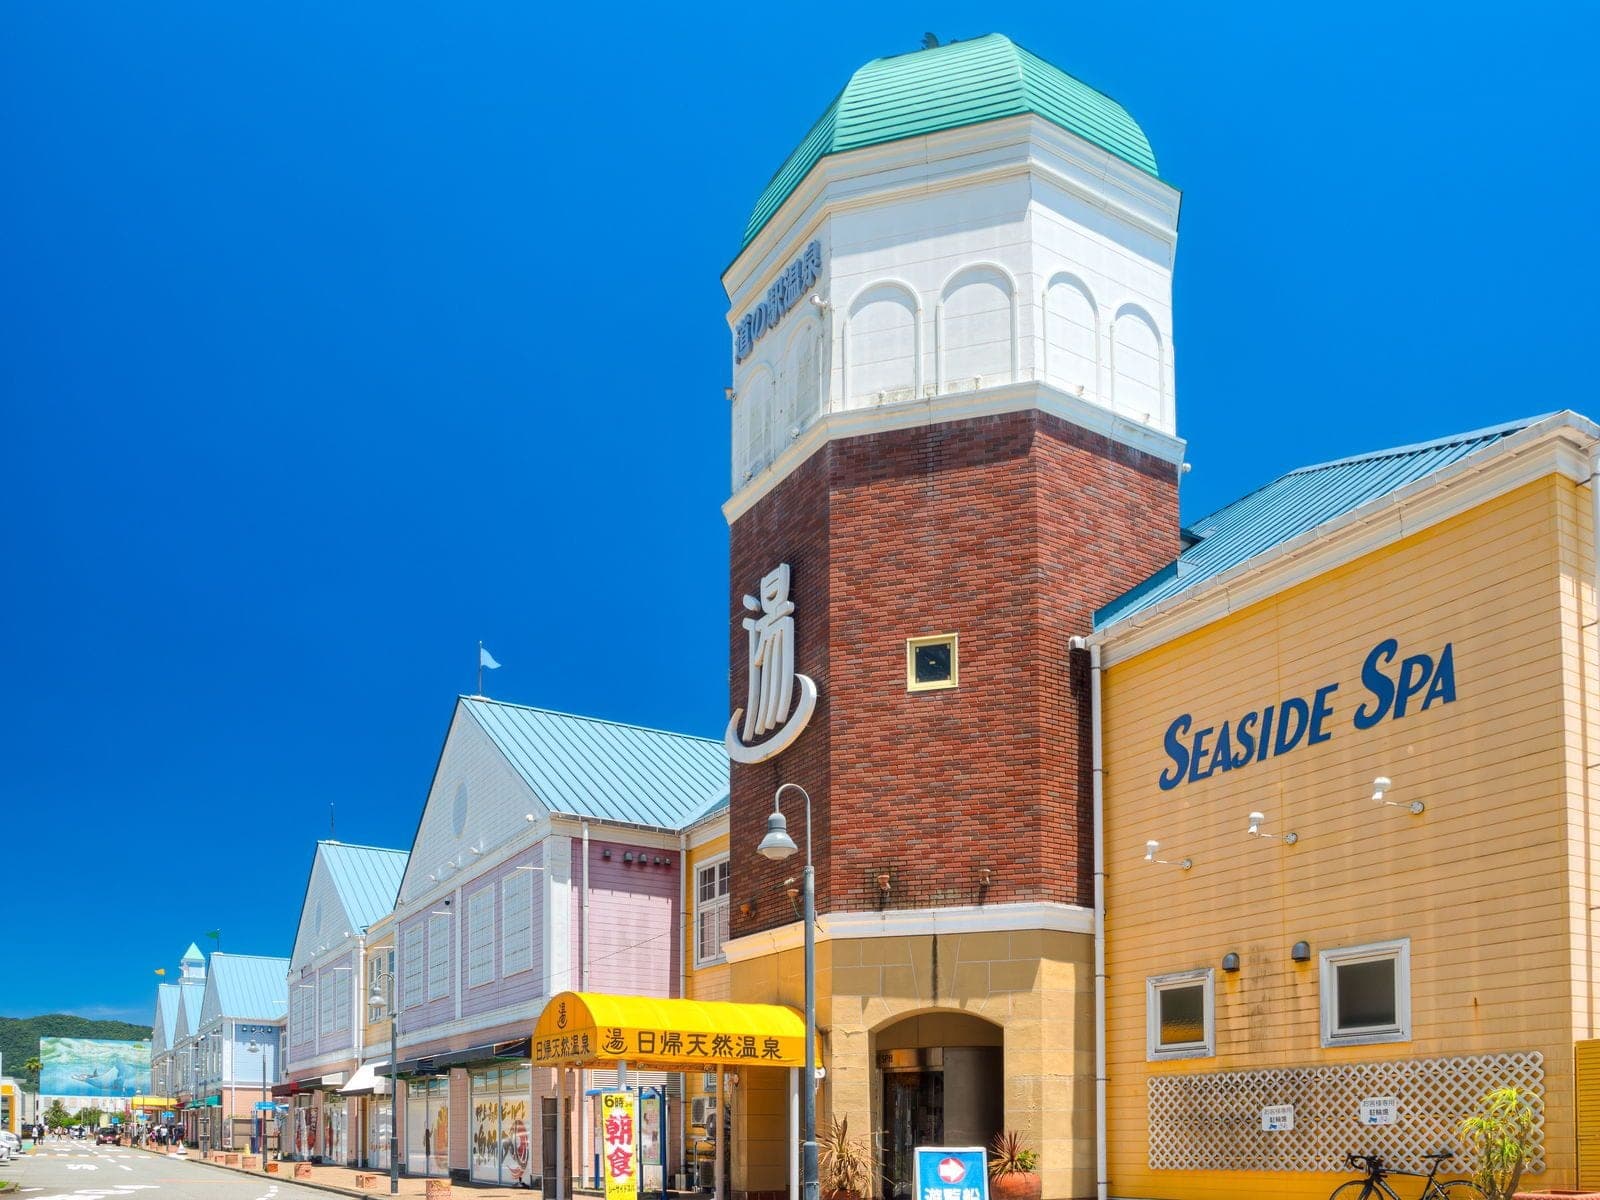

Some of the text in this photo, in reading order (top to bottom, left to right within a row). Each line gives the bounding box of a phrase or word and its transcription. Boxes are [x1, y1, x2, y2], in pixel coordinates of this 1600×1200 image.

[1159, 638, 1457, 791] SEASIDE SPA
[536, 1033, 590, 1061] 日帰天然温泉
[602, 1028, 783, 1060] 湯 日帰天然温泉
[605, 1114, 634, 1177] 朝食
